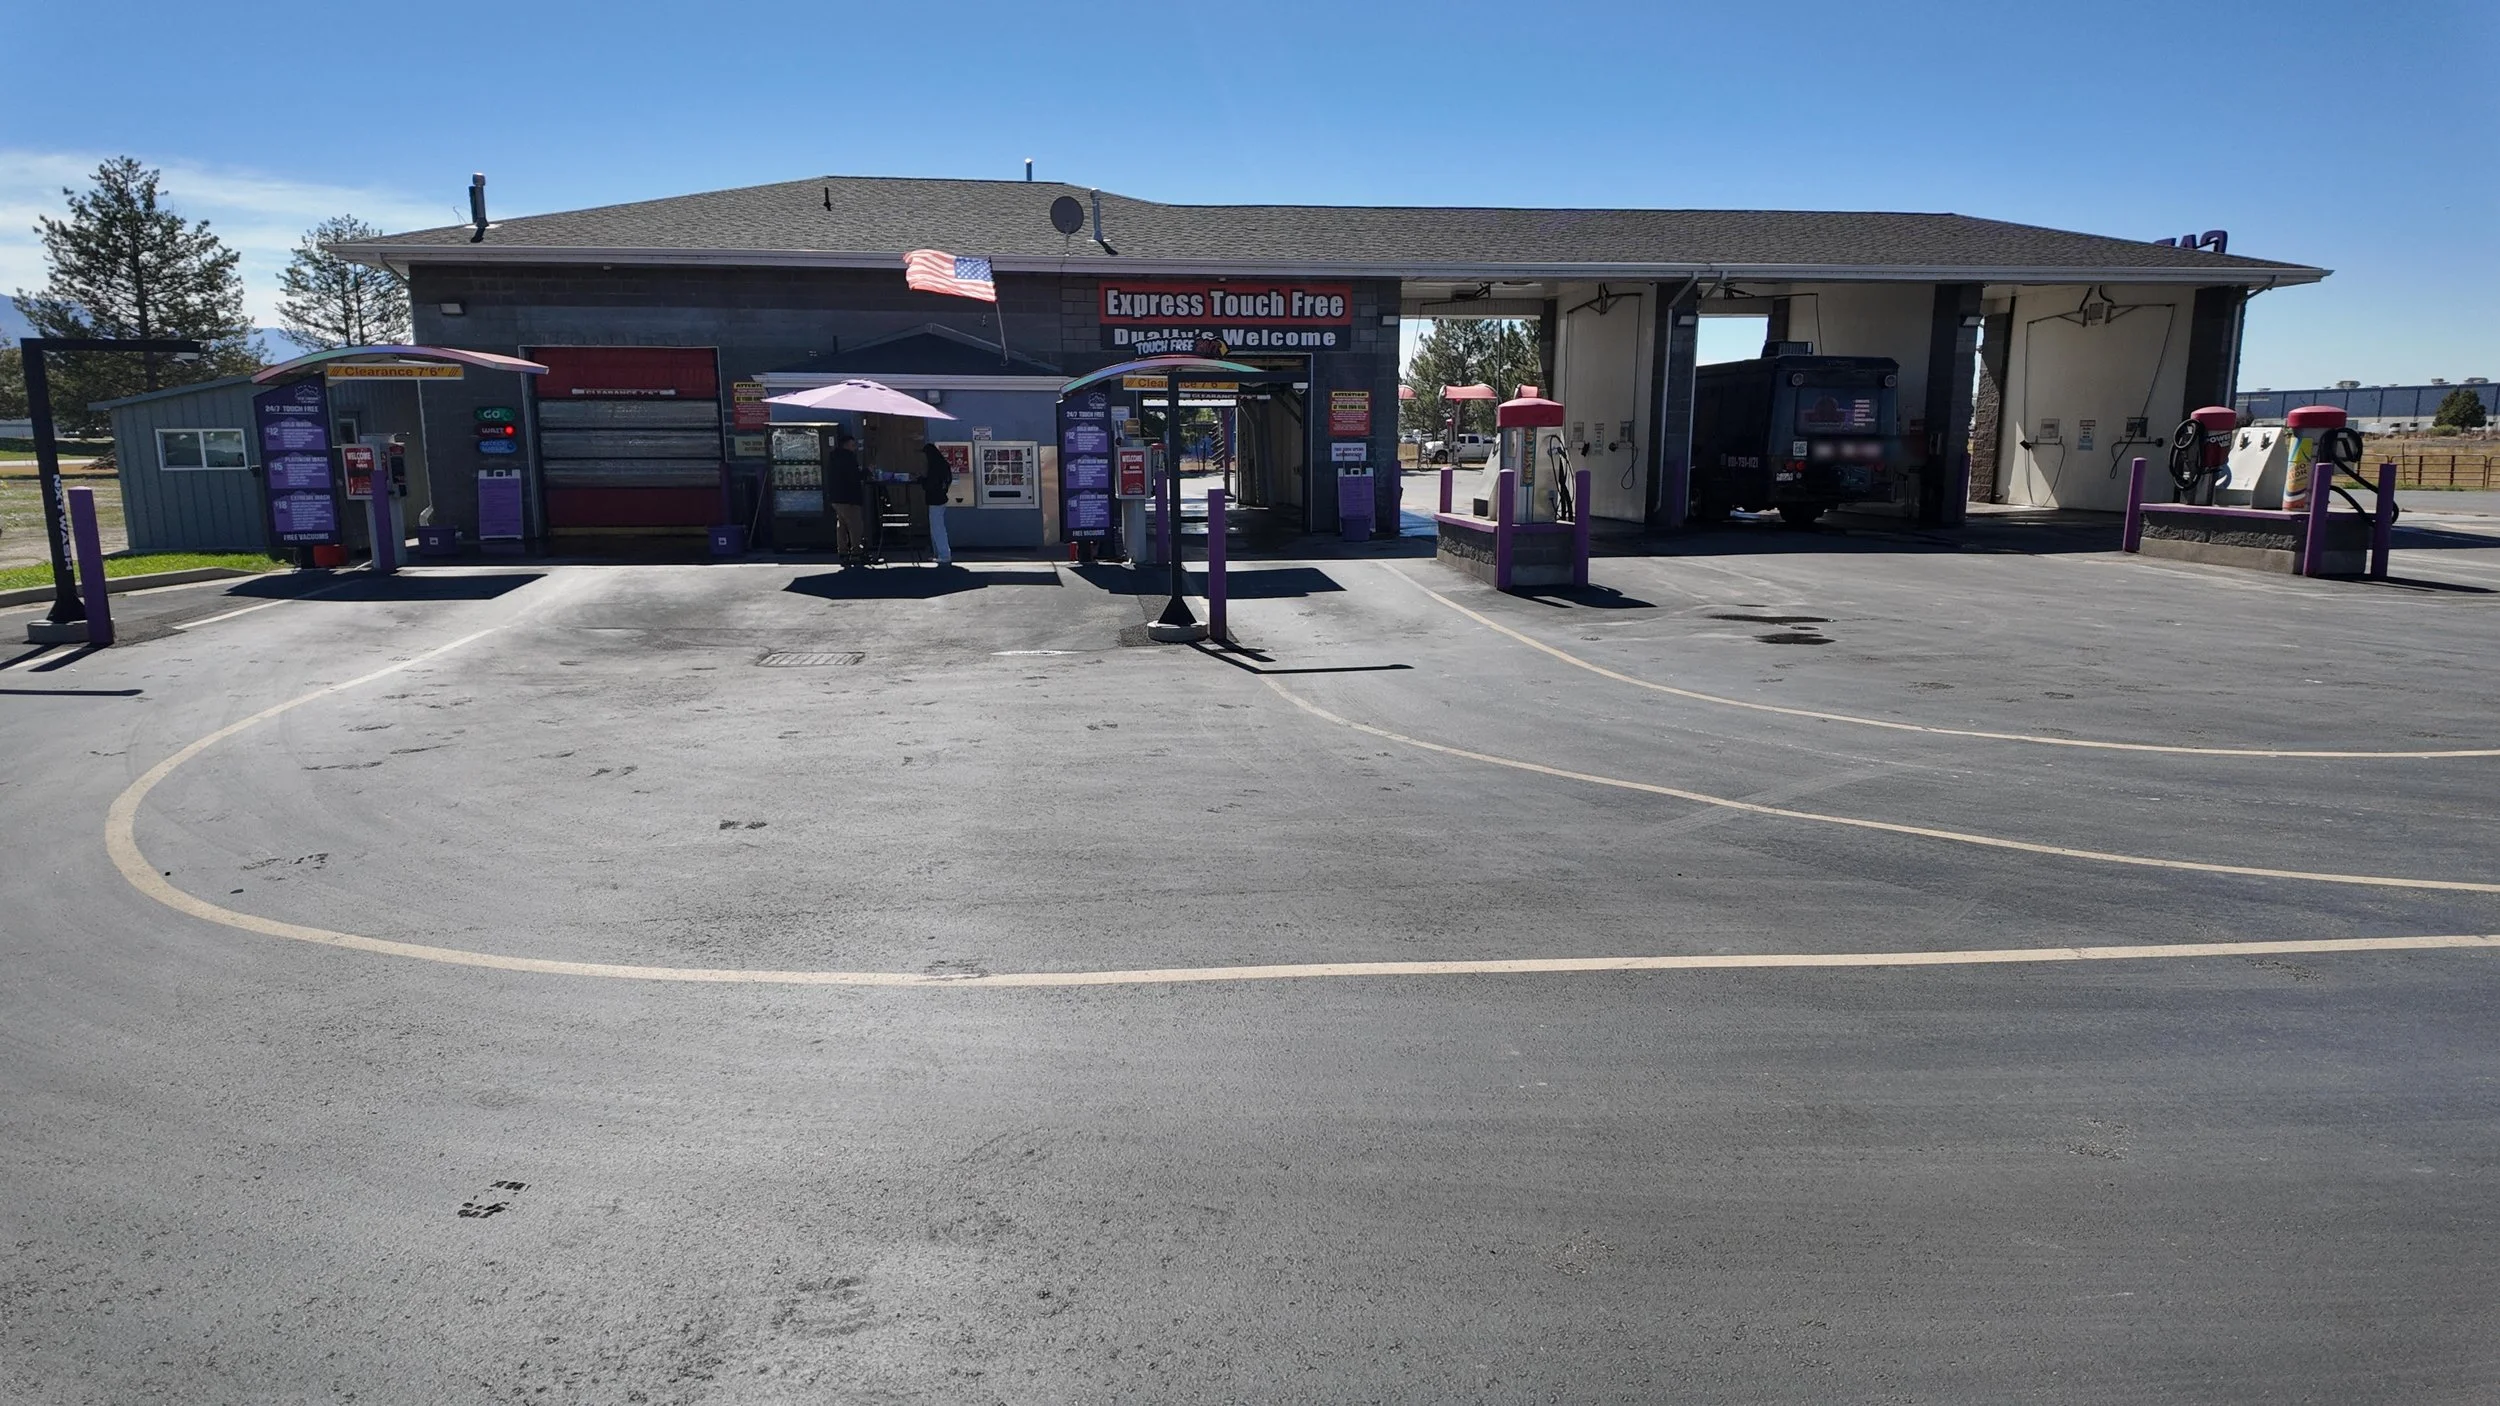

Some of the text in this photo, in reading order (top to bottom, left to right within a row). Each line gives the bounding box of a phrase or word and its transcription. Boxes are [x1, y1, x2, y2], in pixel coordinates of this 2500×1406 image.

[1107, 290, 1344, 318] Express Touch Free
[1222, 329, 1336, 346] Welcome
[1135, 340, 1168, 355] TOUCH
[1170, 339, 1195, 352] FREE
[345, 367, 413, 376] Clearance
[1138, 378, 1197, 388] Clearce
[483, 409, 500, 419] GO
[346, 452, 372, 460] WELCOME
[1122, 455, 1143, 463] WELCOME
